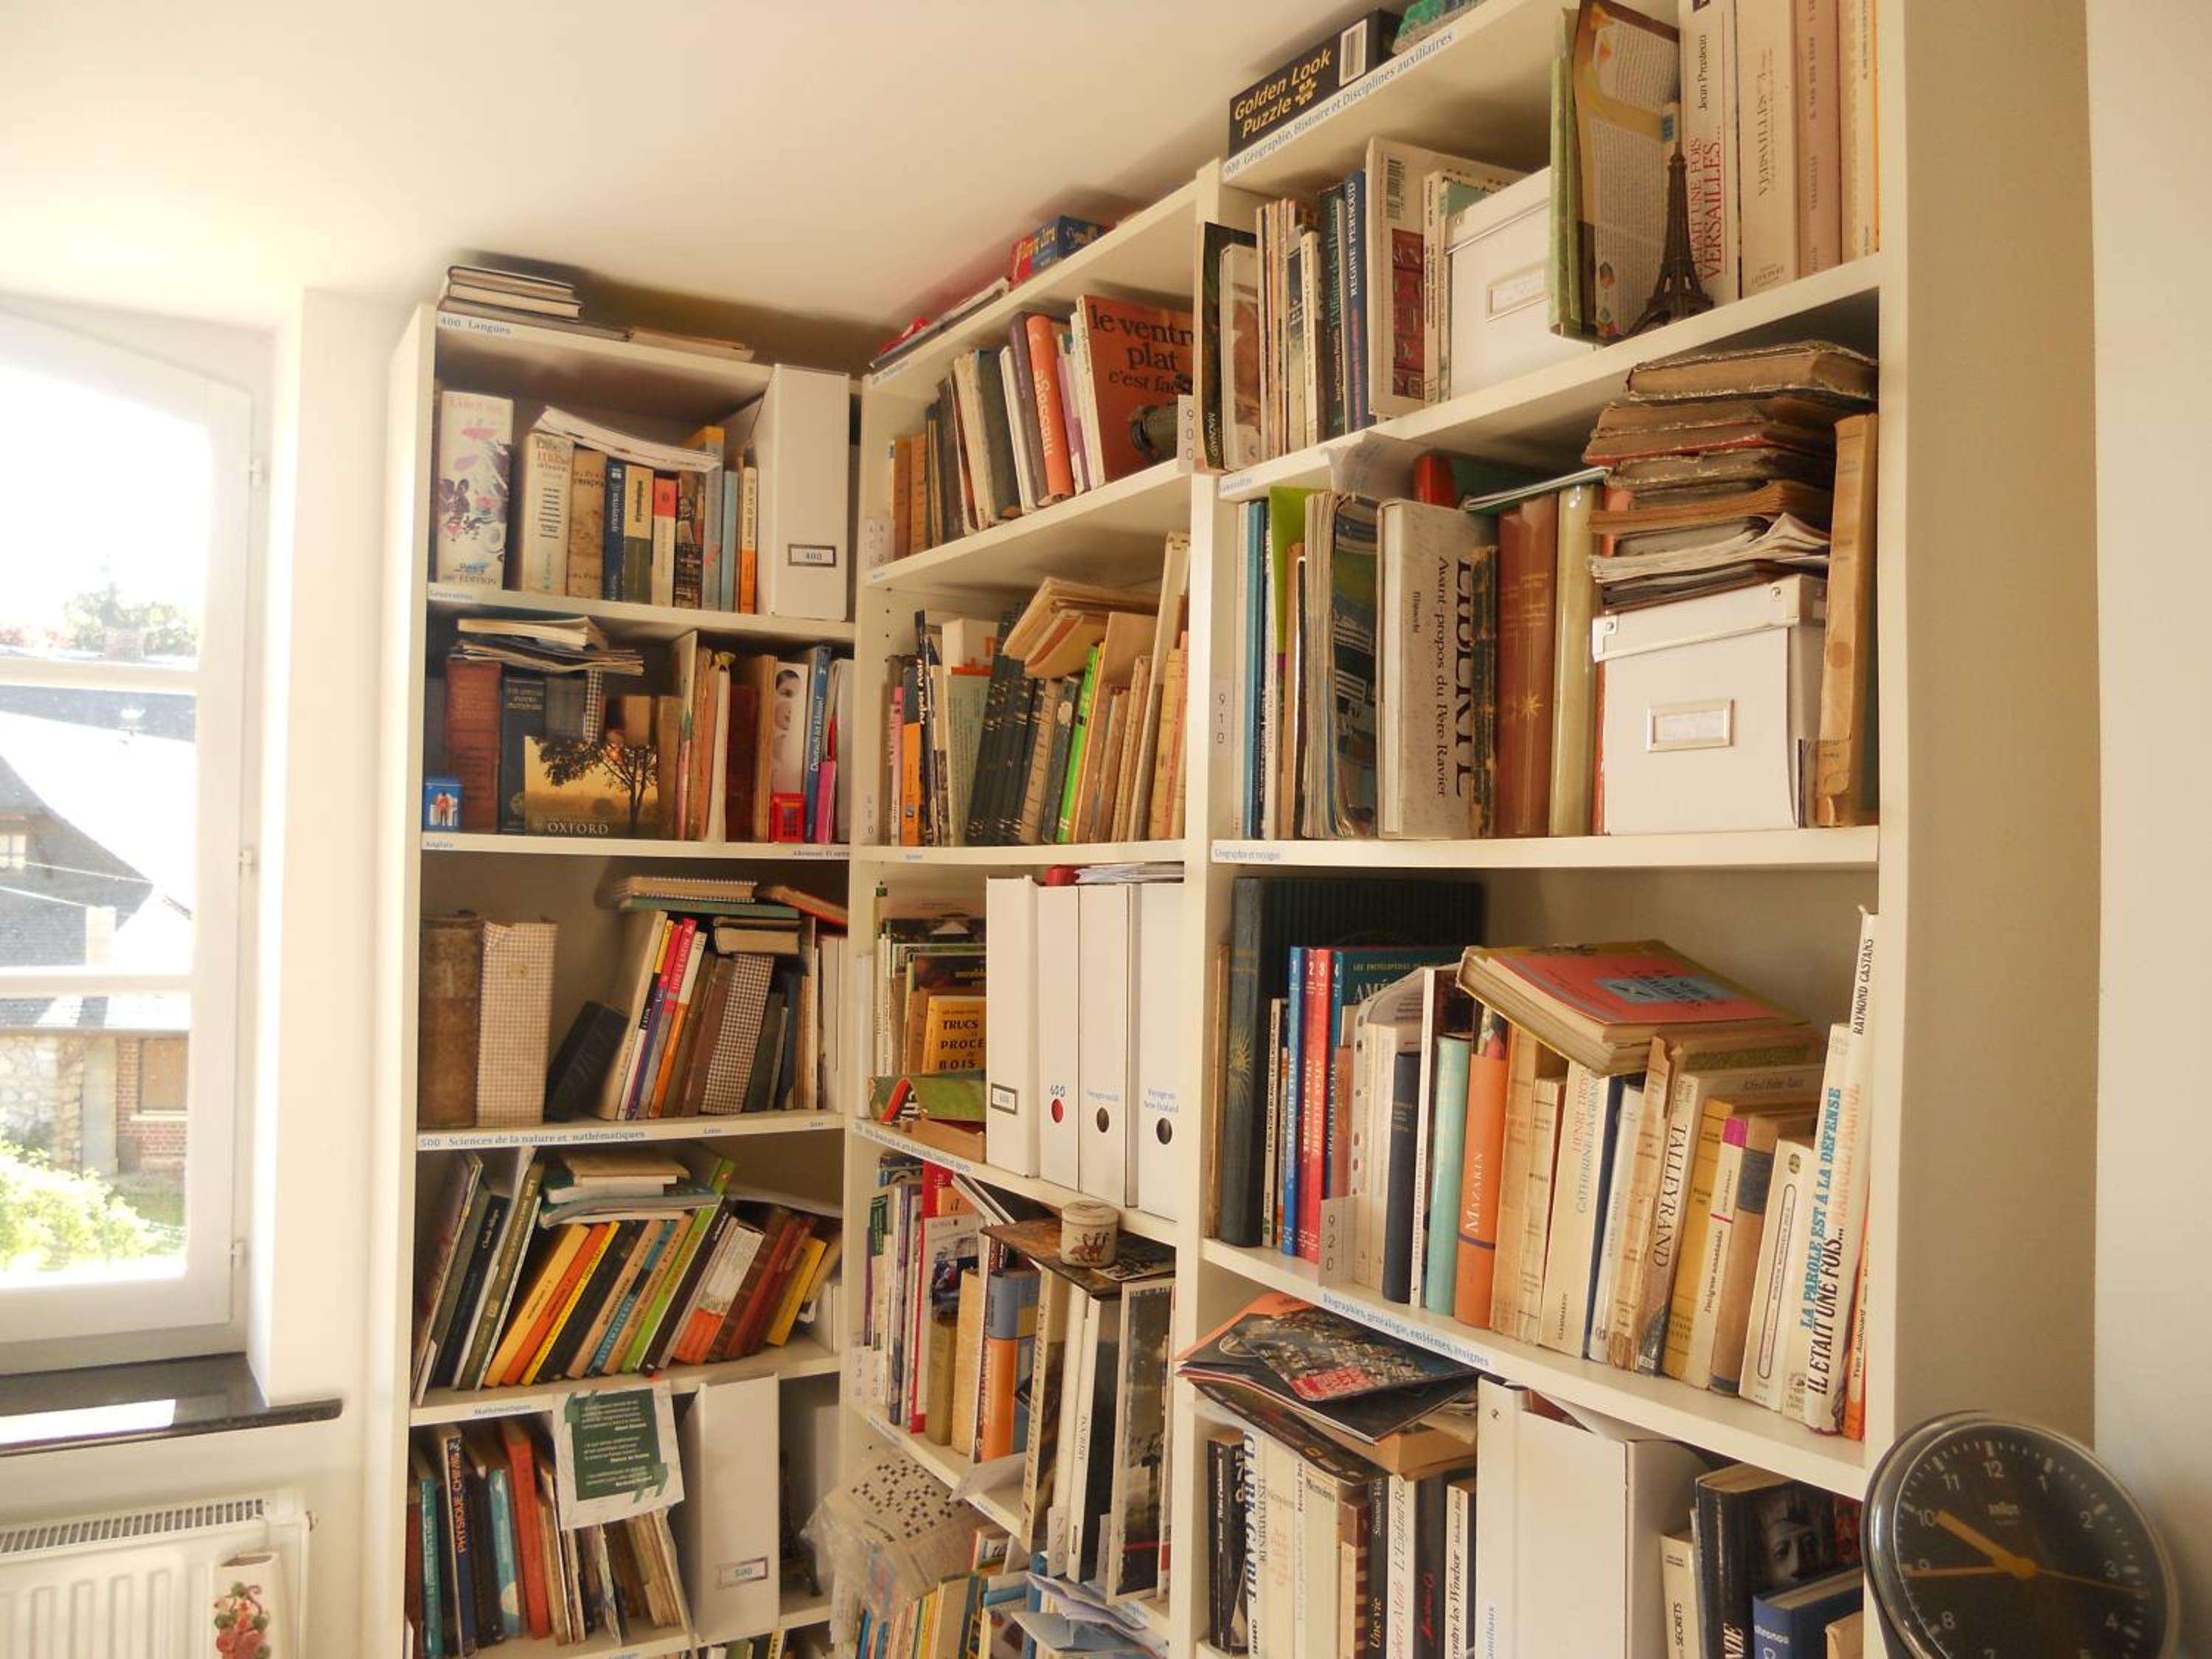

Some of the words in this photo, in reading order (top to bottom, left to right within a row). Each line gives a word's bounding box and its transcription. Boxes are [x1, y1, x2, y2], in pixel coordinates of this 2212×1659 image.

[1235, 77, 1287, 120] Golden
[1292, 47, 1330, 86] Look
[1342, 69, 1395, 106] Disciplines
[1397, 32, 1452, 74] auxiliaires
[1698, 83, 1708, 111] Jean
[1242, 97, 1292, 138] Puzzle
[1690, 138, 1701, 174] FOIS
[1347, 182, 1357, 246] PERNOUD
[1348, 248, 1357, 298] REGINE
[469, 320, 510, 335] Langues
[1090, 305, 1115, 332] le
[1119, 317, 1194, 347] ventr
[1127, 341, 1178, 371] plat
[1108, 371, 1147, 389] c'est
[1434, 556, 1450, 669] Avant-propos
[1436, 675, 1448, 698] du
[1436, 703, 1449, 739] Père
[1436, 744, 1449, 797] Ravier
[548, 822, 609, 835] OXFORD
[1859, 938, 1875, 984] CASTANS
[943, 1020, 979, 1030] TRUCS
[1852, 986, 1868, 1036] RAYMOND
[940, 1037, 986, 1050] PROCE
[939, 1060, 975, 1071] BOIS
[1579, 1068, 1590, 1110] TROY
[420, 1138, 441, 1147] 500
[448, 1135, 493, 1147] Sciences
[495, 1135, 507, 1144] de
[509, 1135, 519, 1144] la
[521, 1133, 557, 1144] nature
[558, 1134, 568, 1143] et
[1820, 1088, 1842, 1164] DEFENSE
[1577, 1146, 1593, 1215] CATHERINE
[1589, 1079, 1599, 1122] GRAN
[1465, 1151, 1484, 1234] MAZARIN
[1652, 1124, 1688, 1268] TALLEYRAND
[1817, 1169, 1833, 1195] LA
[1811, 1206, 1829, 1239] EST
[1803, 1241, 1823, 1304] PAROLE
[1821, 1282, 1837, 1318] UNE
[1800, 1307, 1815, 1331] LA
[1810, 1321, 1834, 1375] ETAIT
[1806, 1379, 1828, 1396] IL
[1244, 1433, 1256, 1515] CLARK
[1941, 1473, 1960, 1491] 11
[1983, 1460, 2004, 1478] 12
[2038, 1475, 2048, 1492] 1
[454, 1496, 467, 1554] PHYSIQUE
[1258, 1499, 1267, 1548] FEMMES
[1374, 1498, 1382, 1537] Simone
[1917, 1509, 1936, 1527] 10
[2079, 1510, 2094, 1529] 2
[1245, 1522, 1257, 1604] GABLE
[1449, 1549, 1463, 1602] Windsor
[2104, 1559, 2119, 1579] 3
[1371, 1596, 1381, 1618] vie
[1449, 1605, 1461, 1623] les
[1673, 1601, 1683, 1647] SECRETS
[1941, 1610, 1955, 1630] 8
[2106, 1612, 2119, 1630] 4
[1368, 1621, 1381, 1649] Une
[1486, 1604, 1498, 1659] amiliaux
[1754, 1624, 1790, 1645] chronos
